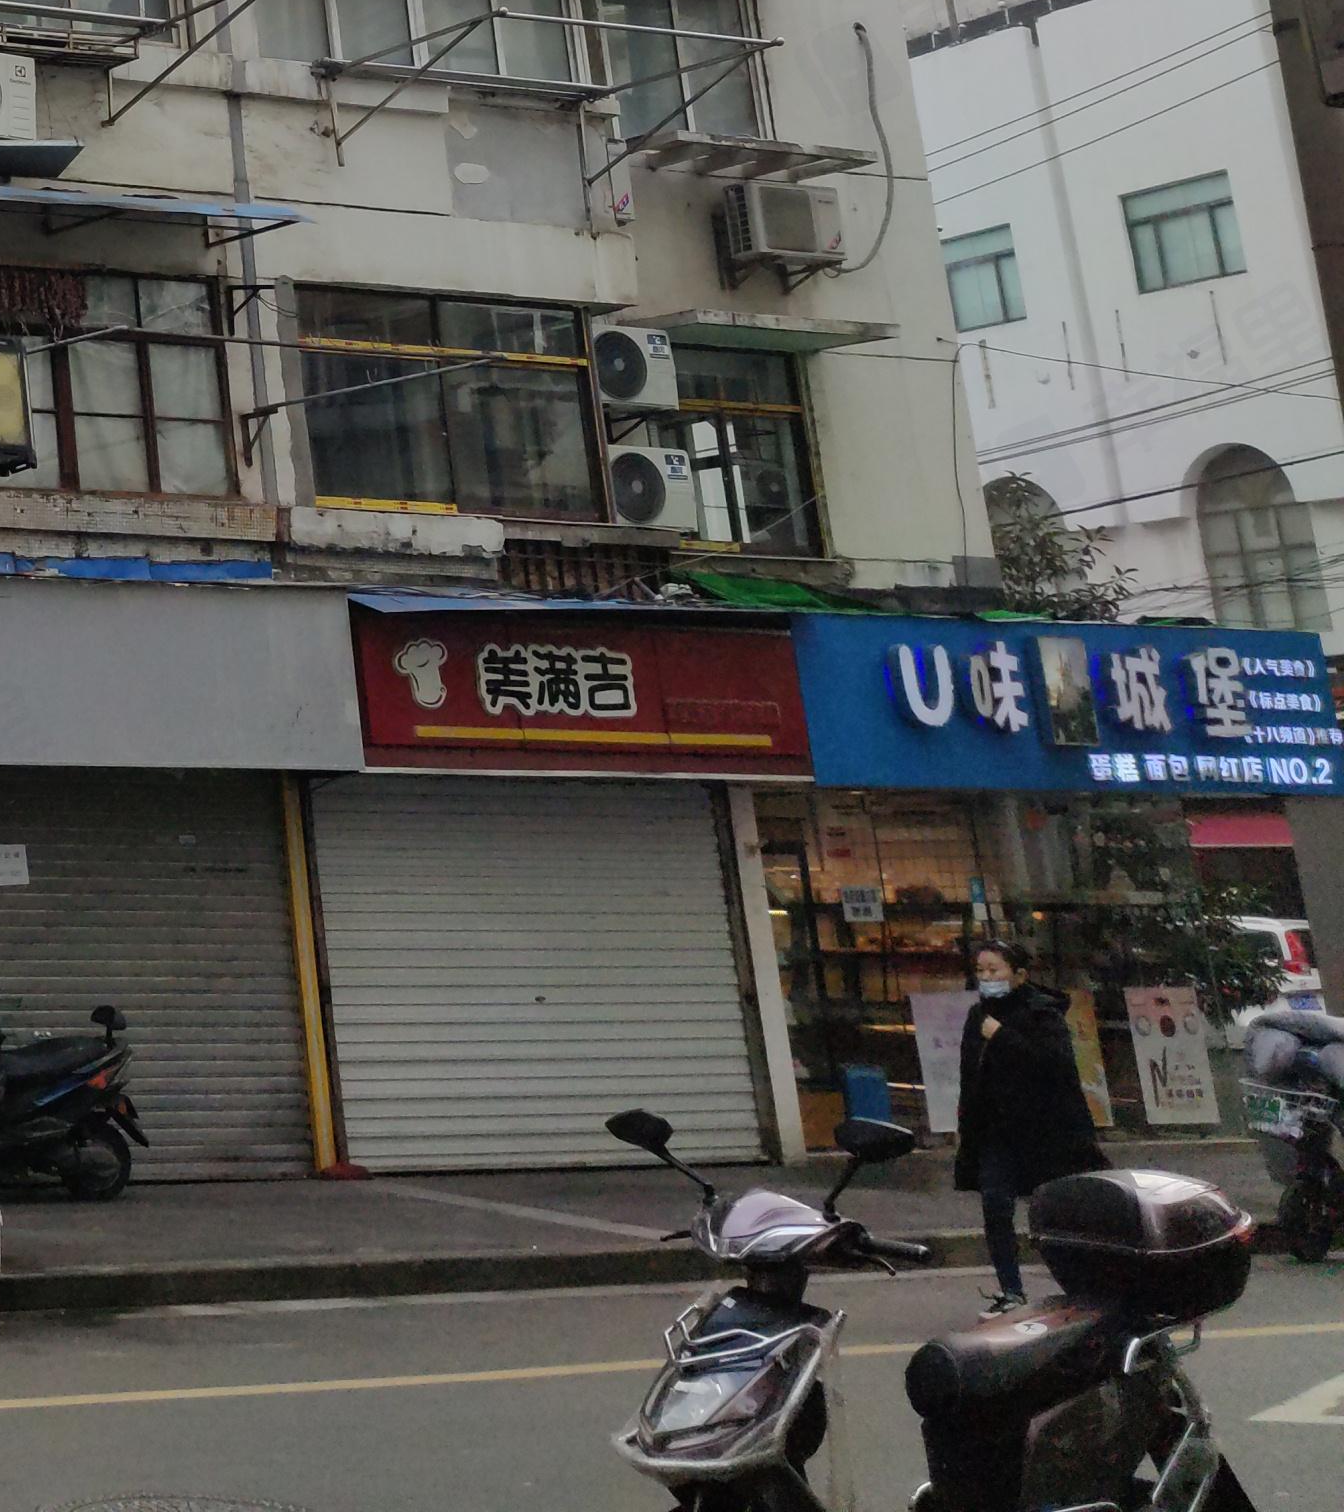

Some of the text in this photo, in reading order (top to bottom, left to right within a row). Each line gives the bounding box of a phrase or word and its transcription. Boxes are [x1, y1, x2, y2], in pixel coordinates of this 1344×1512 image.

[479, 645, 635, 715] 美满吉
[1267, 756, 1334, 785] NO.2
